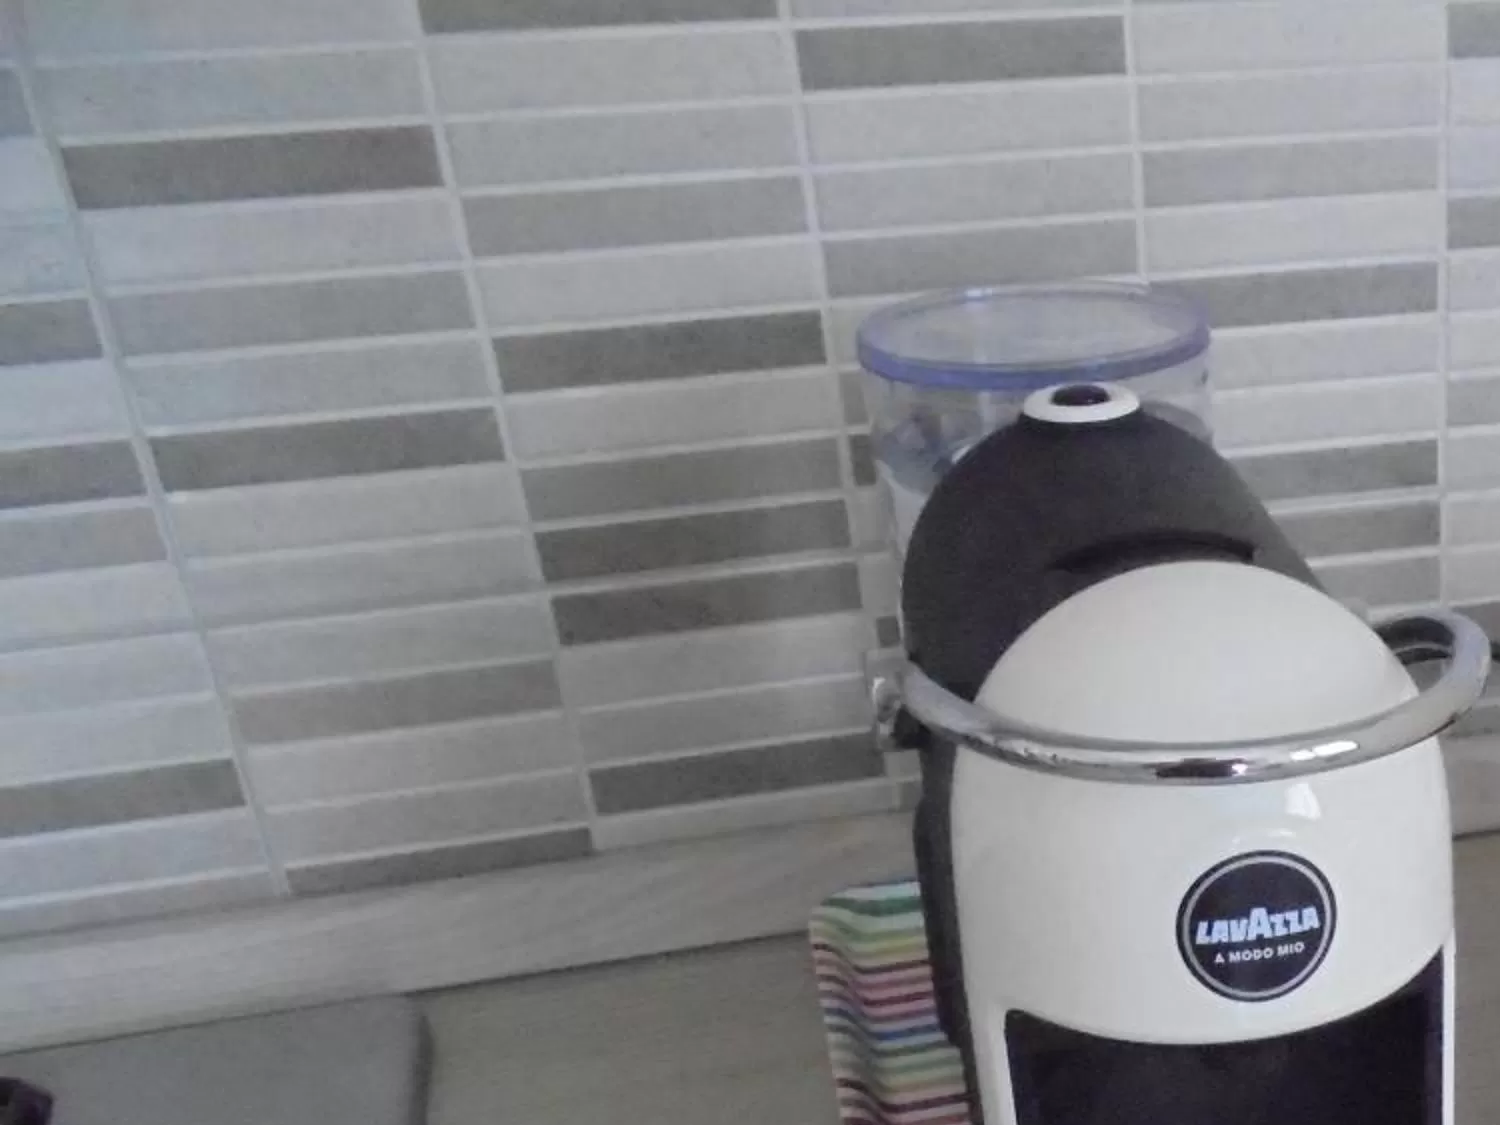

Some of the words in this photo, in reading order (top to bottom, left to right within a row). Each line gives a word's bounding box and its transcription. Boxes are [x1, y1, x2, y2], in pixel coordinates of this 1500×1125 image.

[1196, 906, 1321, 944] LAVAZZA
[1214, 953, 1226, 965] A
[1229, 949, 1274, 963] MODO
[1278, 942, 1306, 957] MIO
